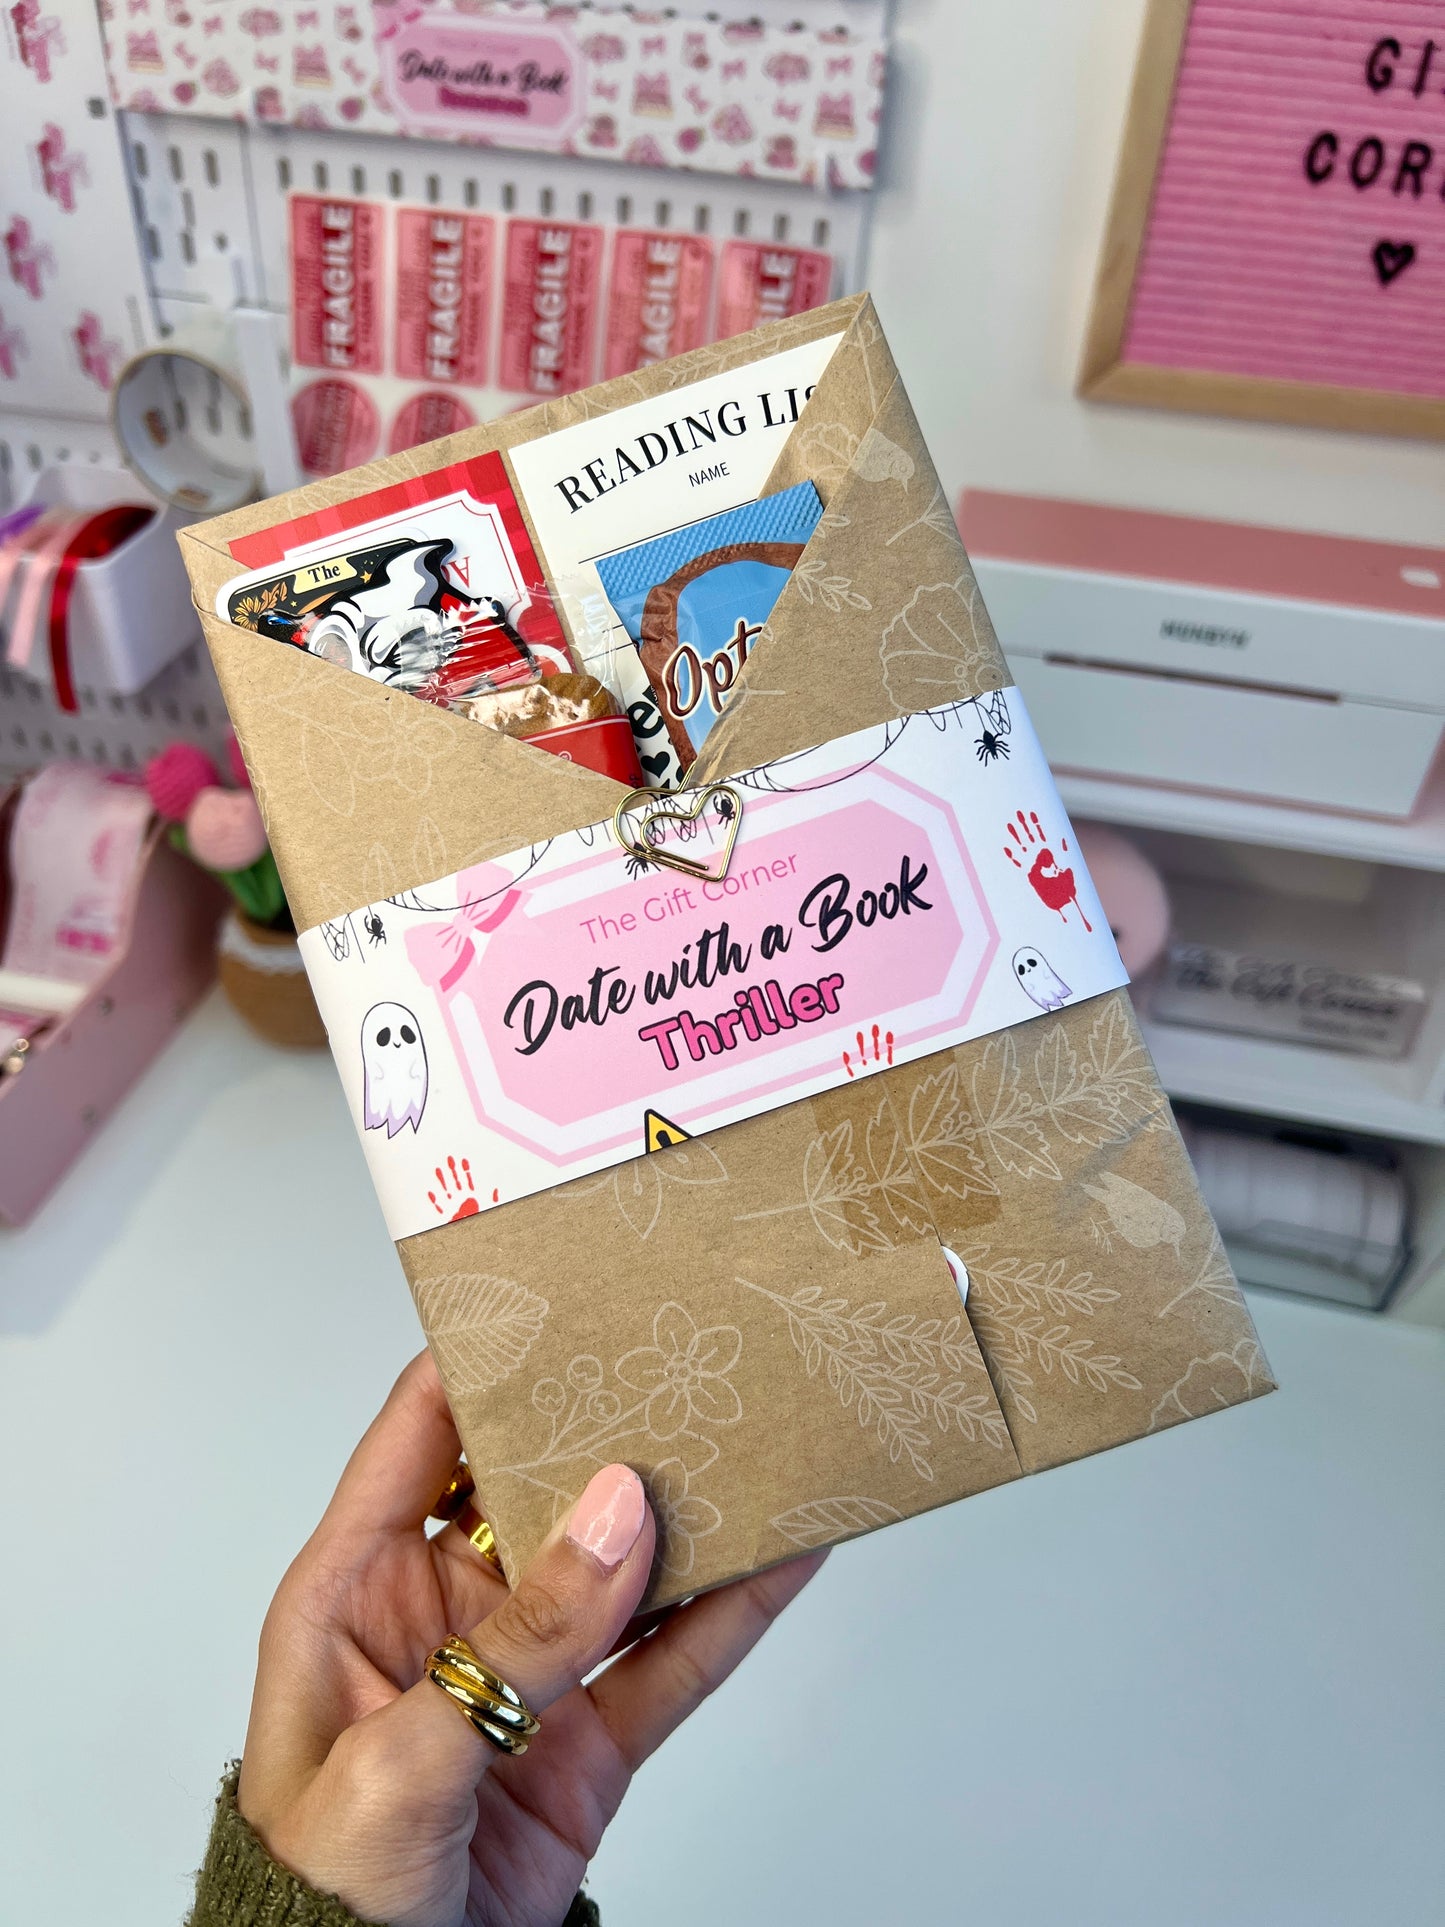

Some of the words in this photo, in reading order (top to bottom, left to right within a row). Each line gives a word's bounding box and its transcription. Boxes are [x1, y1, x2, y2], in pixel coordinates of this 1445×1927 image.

[1366, 36, 1445, 97] GI
[1305, 130, 1445, 198] COR
[322, 203, 354, 367] FRAGILE
[429, 217, 464, 379] FRAGILE
[521, 229, 571, 391] FRAGILE
[637, 239, 682, 368] AGILE
[553, 401, 748, 515] READING
[688, 461, 730, 487] NAME
[308, 564, 341, 583] The
[580, 913, 637, 945] The
[643, 888, 699, 924] Gift
[702, 854, 797, 903] Corner
[504, 965, 636, 1056] Date
[643, 921, 752, 1005] with
[760, 923, 793, 960] a
[798, 854, 933, 953] Book
[638, 973, 844, 1072] Thriller
